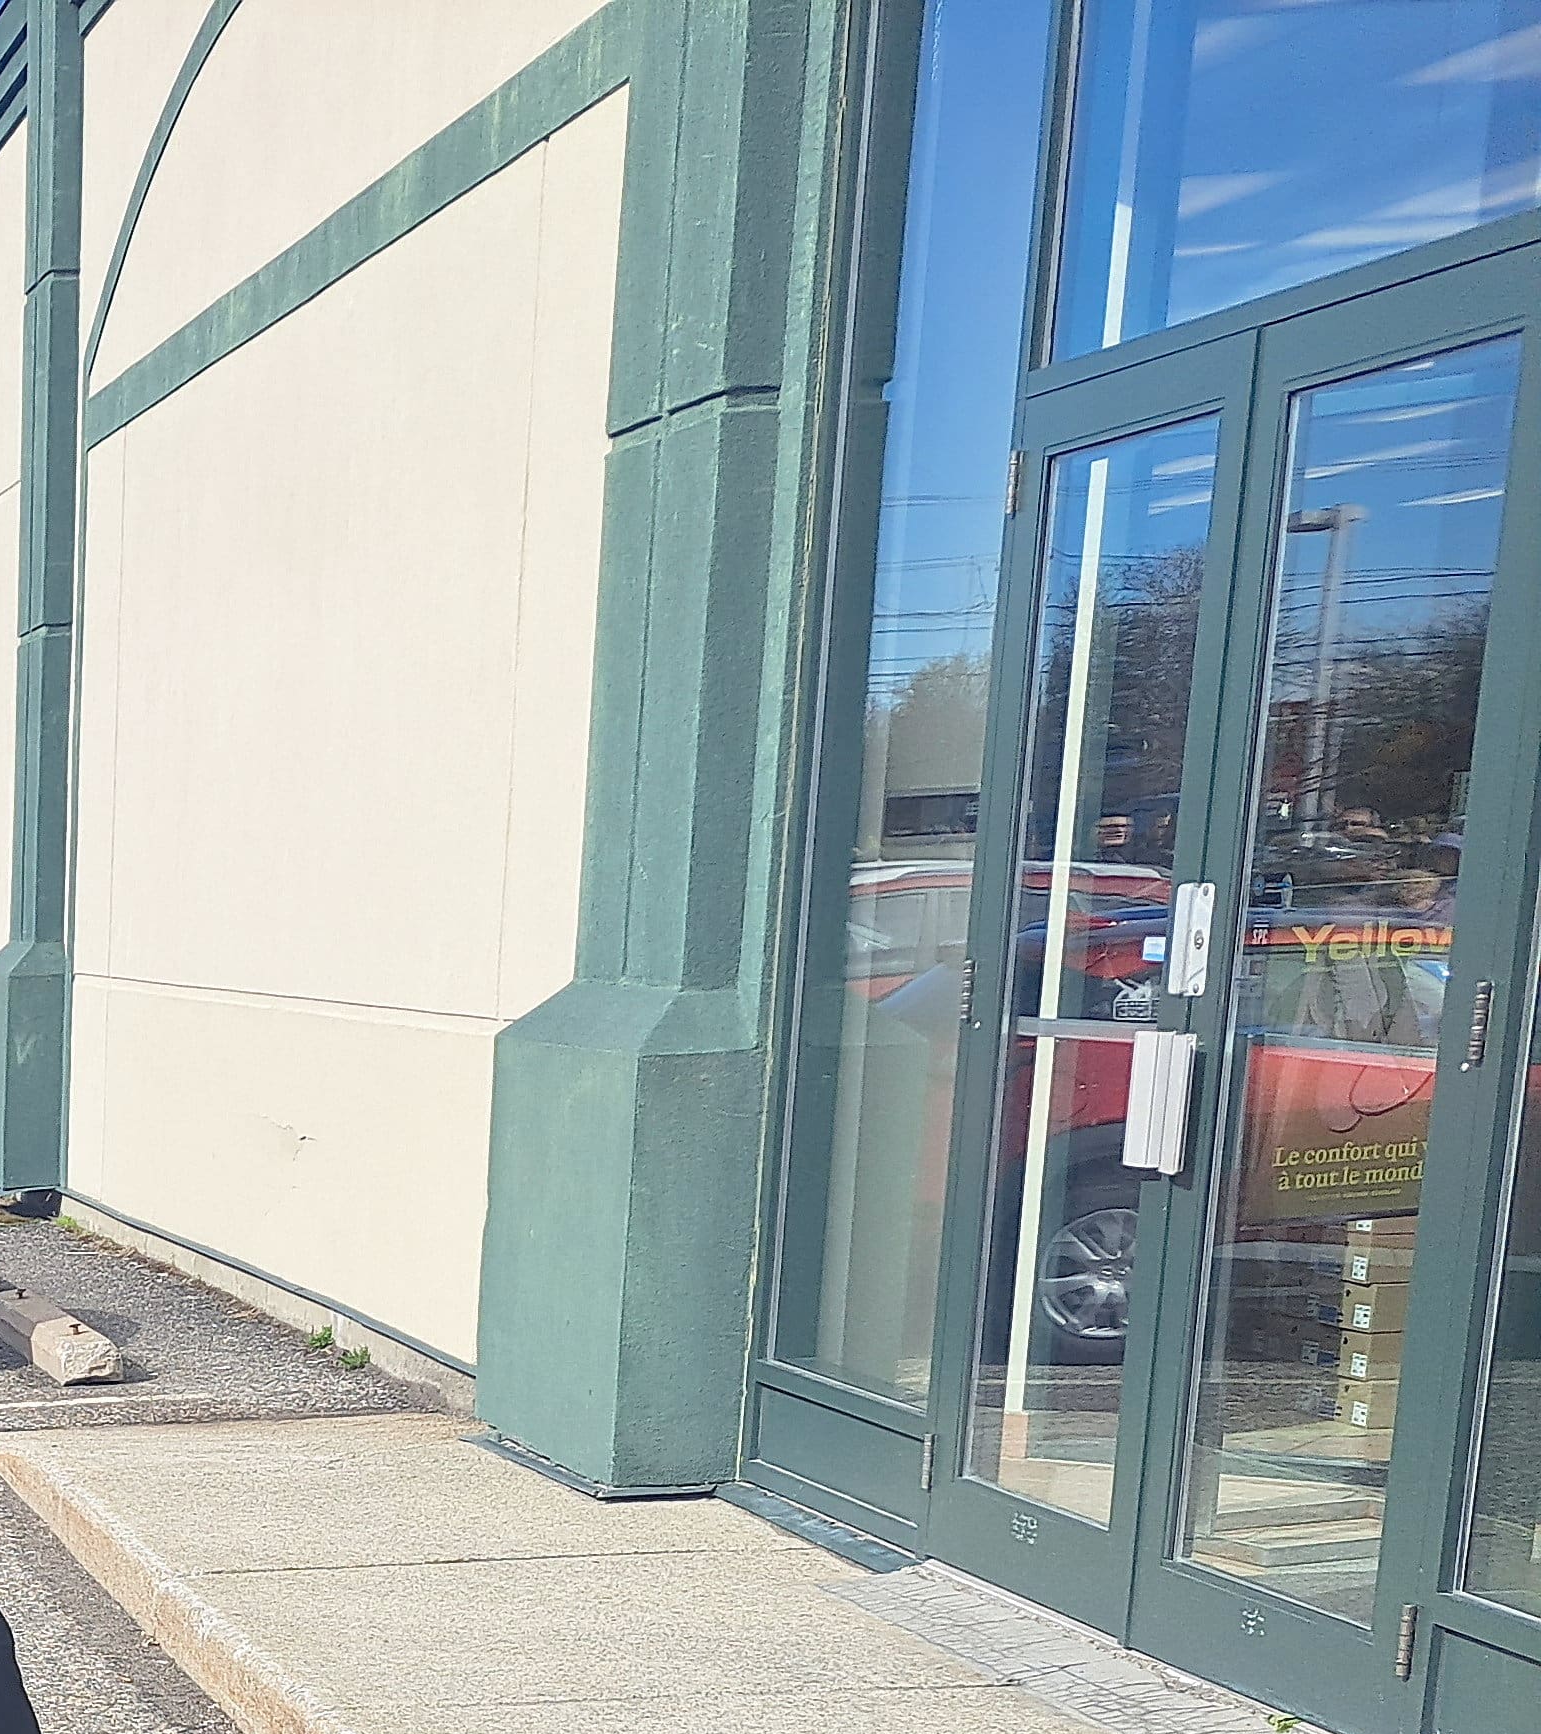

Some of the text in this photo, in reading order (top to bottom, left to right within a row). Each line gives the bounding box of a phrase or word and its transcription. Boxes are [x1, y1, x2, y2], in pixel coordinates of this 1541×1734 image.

[1272, 1147, 1300, 1168] Le
[1303, 1141, 1384, 1165] confort
[1384, 1136, 1418, 1163] qui
[1277, 1170, 1291, 1191] à
[1295, 1171, 1340, 1190] tout
[1342, 1166, 1361, 1186] le
